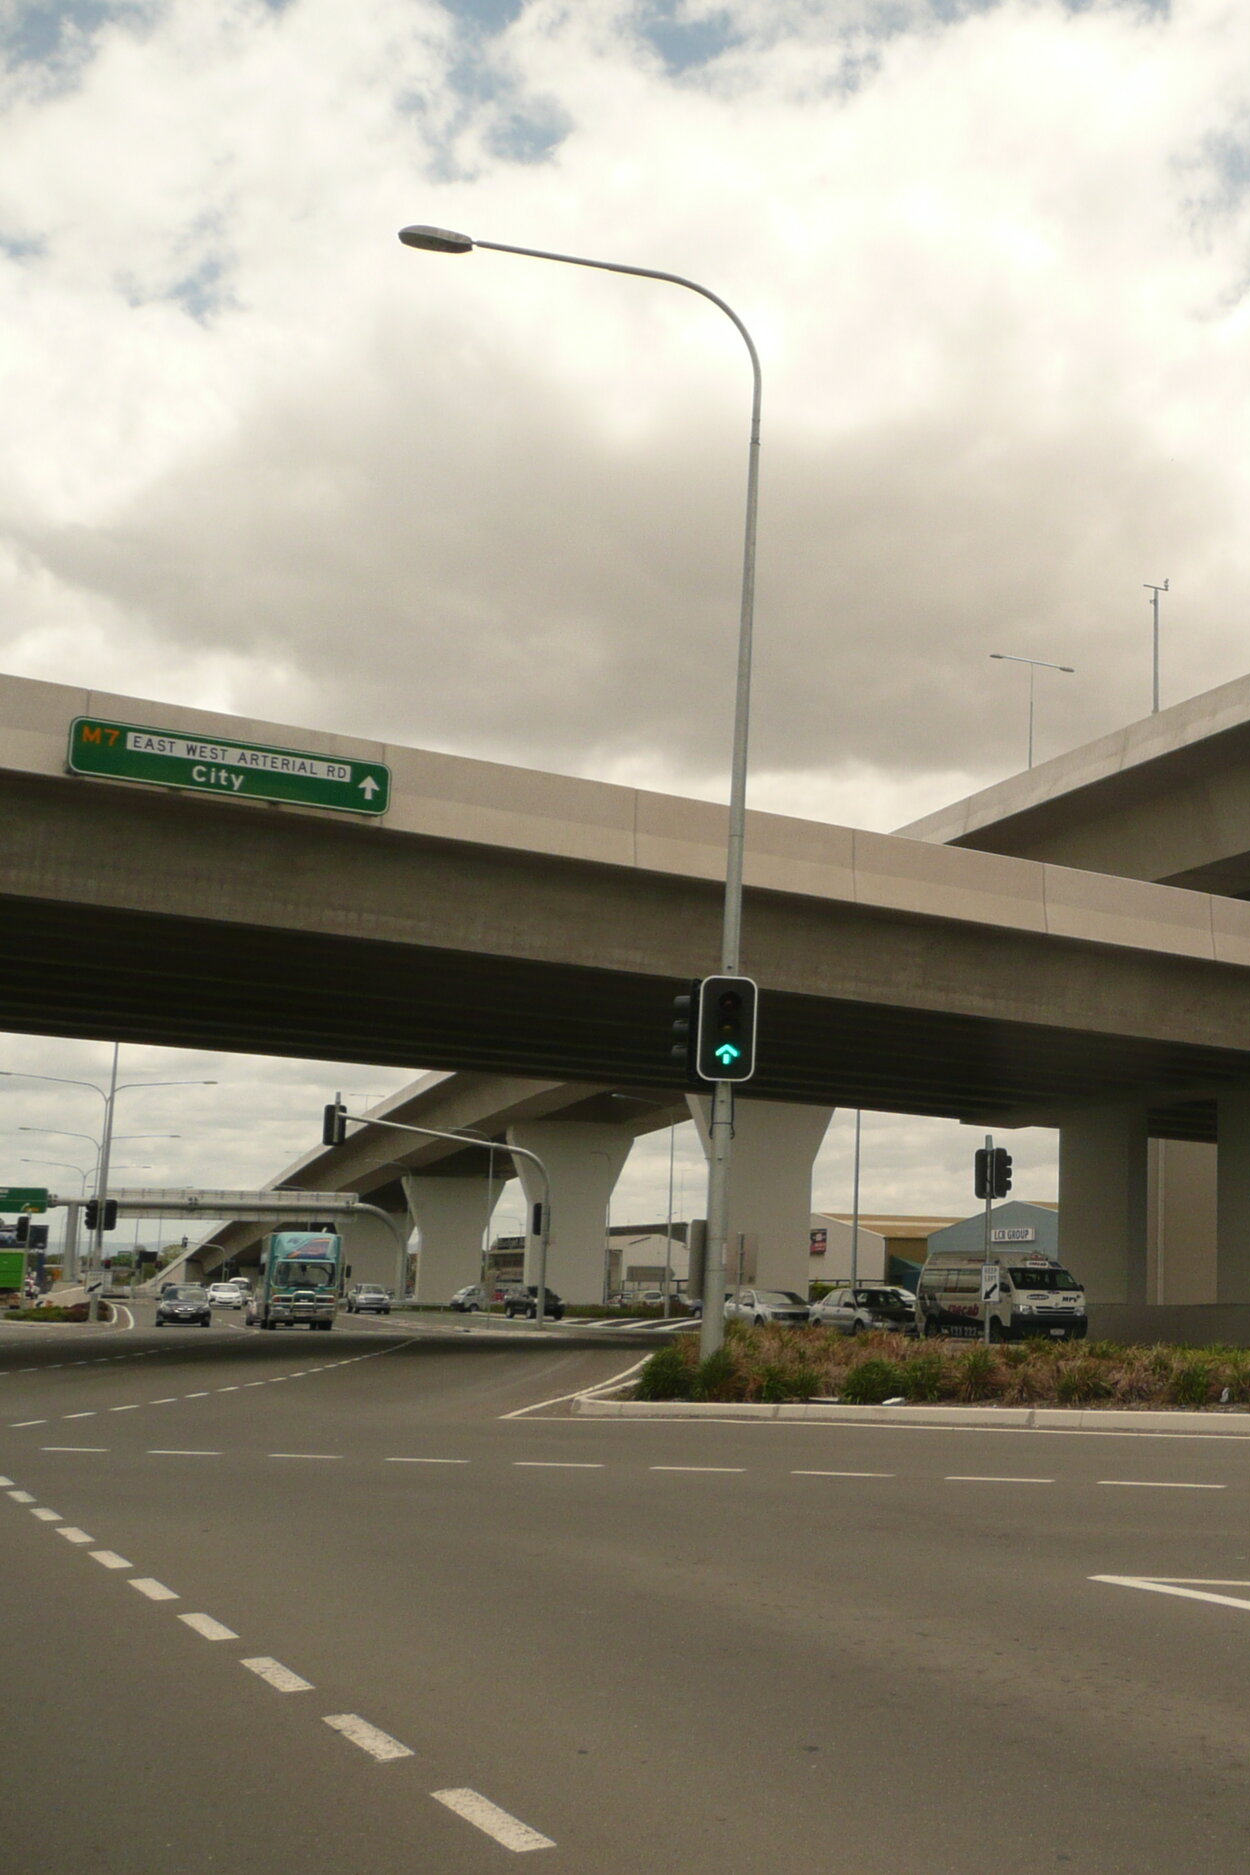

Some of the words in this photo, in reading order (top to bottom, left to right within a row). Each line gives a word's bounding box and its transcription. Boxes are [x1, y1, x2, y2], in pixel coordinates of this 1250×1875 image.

[82, 726, 120, 746] M7
[133, 735, 176, 753] EAST
[186, 743, 228, 761] WEST
[237, 751, 318, 775] ARTERIAL
[326, 765, 347, 779] RD
[192, 765, 244, 791] City
